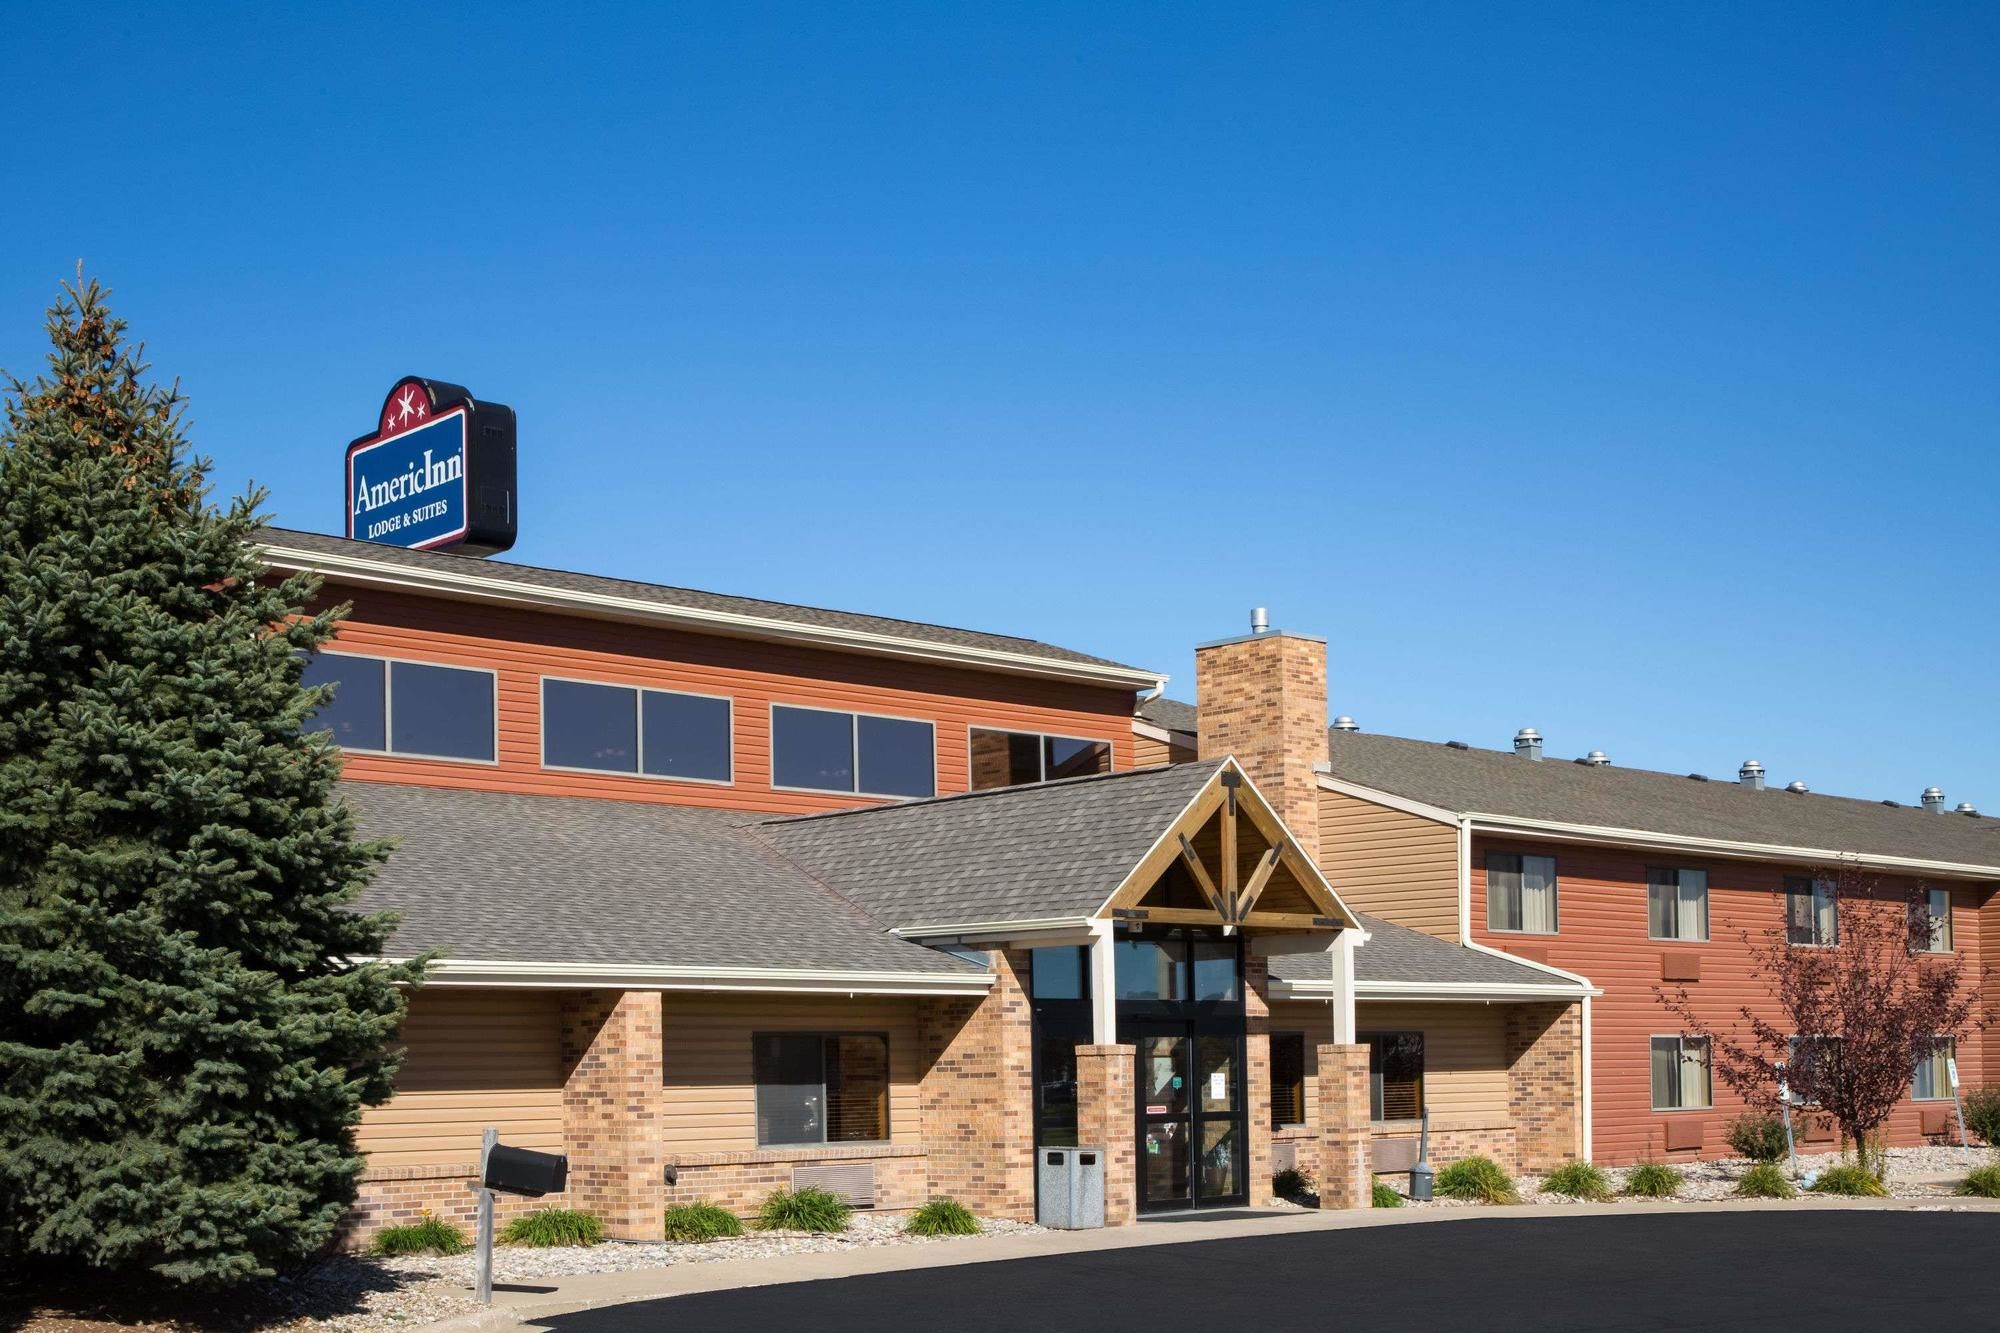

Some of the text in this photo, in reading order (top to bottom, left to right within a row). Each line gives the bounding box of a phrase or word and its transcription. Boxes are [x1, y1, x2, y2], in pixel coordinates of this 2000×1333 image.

[354, 449, 462, 515] AmericInn
[368, 499, 448, 539] LODGE & SUITES
